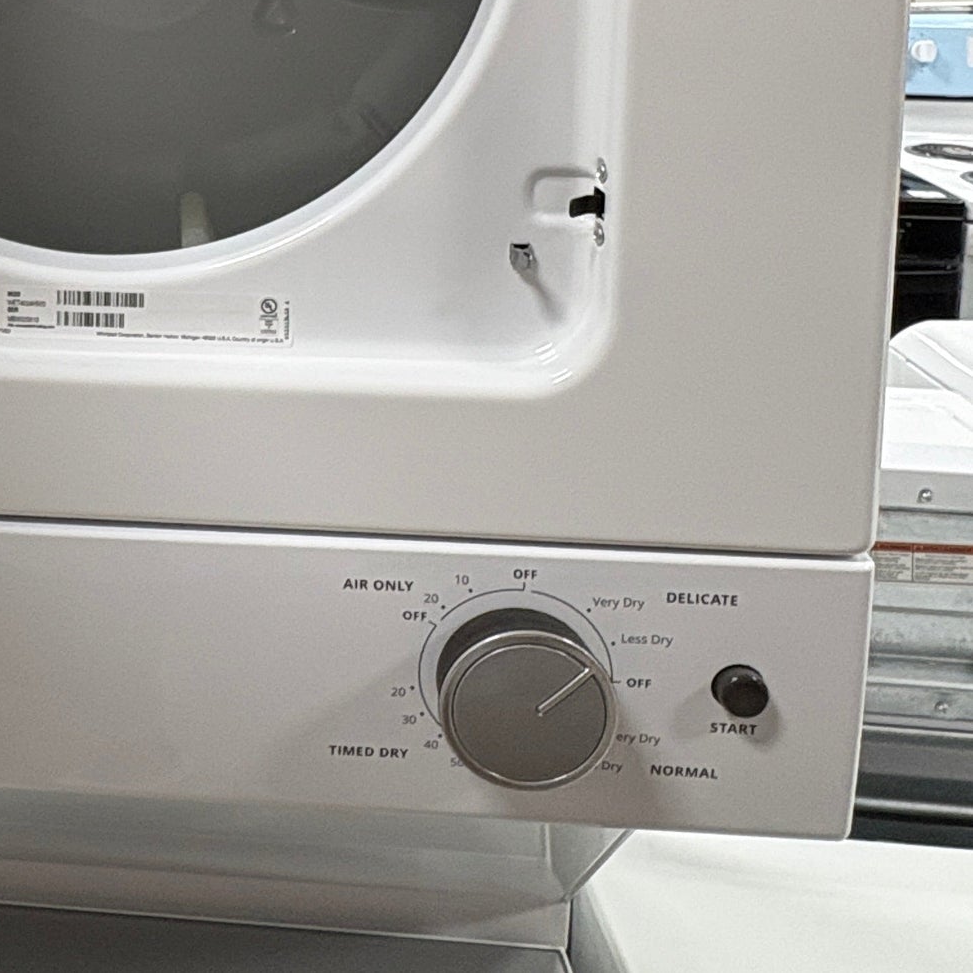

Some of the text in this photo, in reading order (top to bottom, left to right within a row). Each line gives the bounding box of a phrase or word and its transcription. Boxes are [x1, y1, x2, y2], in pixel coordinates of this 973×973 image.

[455, 575, 470, 586] 10
[512, 569, 538, 580] OFF
[343, 578, 414, 593] AIR ONLY
[423, 593, 439, 604] 20
[592, 596, 645, 611] Very Dry
[666, 592, 739, 607] DELICATE
[402, 610, 428, 621] OFF
[621, 633, 674, 648] Less Dry
[626, 678, 652, 689] OFF
[390, 687, 406, 698] 20
[402, 714, 417, 726] 30
[710, 722, 758, 736] START
[423, 739, 439, 750] 40
[615, 733, 661, 747] ery Dry
[329, 745, 409, 760] TIMED DRY
[600, 760, 623, 774] Dry
[649, 764, 719, 781] NORMAL
